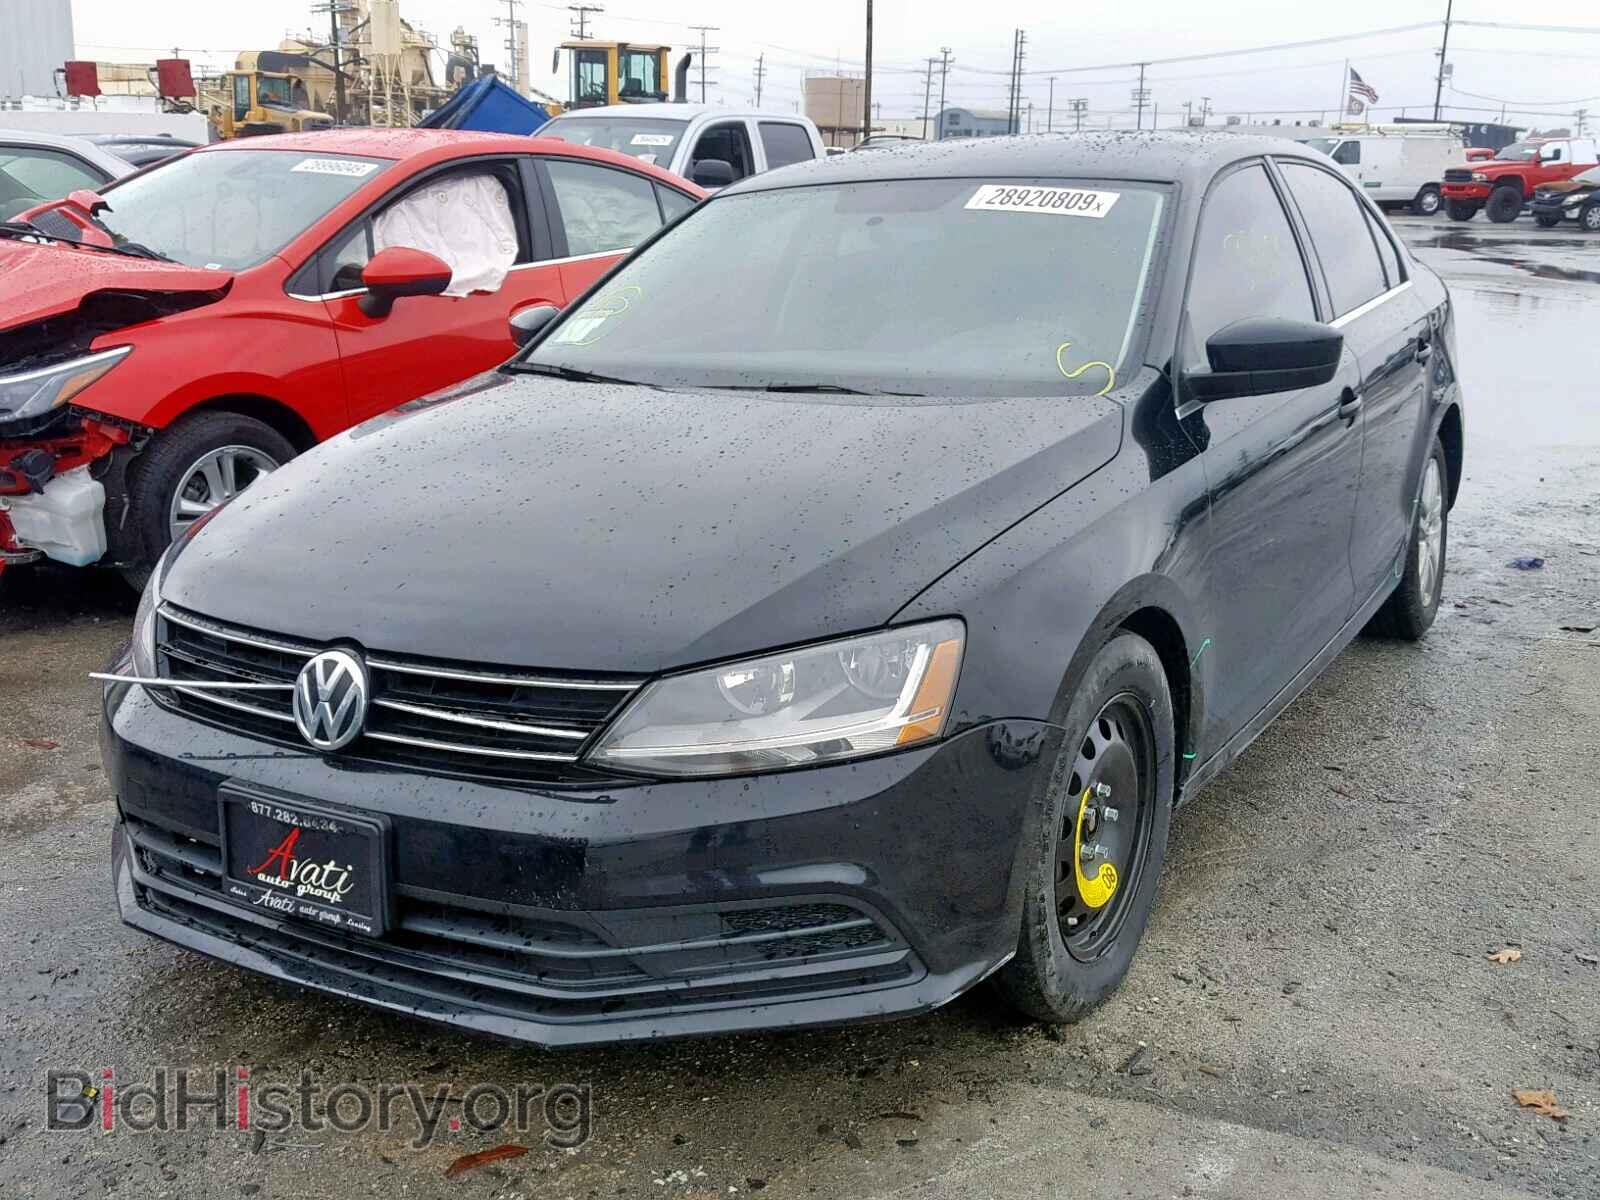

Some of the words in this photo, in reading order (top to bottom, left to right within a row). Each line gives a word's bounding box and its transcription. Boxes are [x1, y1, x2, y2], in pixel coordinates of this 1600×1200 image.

[248, 827, 354, 894] Avati
[253, 888, 296, 913] Avati
[257, 872, 294, 888] auto
[297, 882, 342, 903] group
